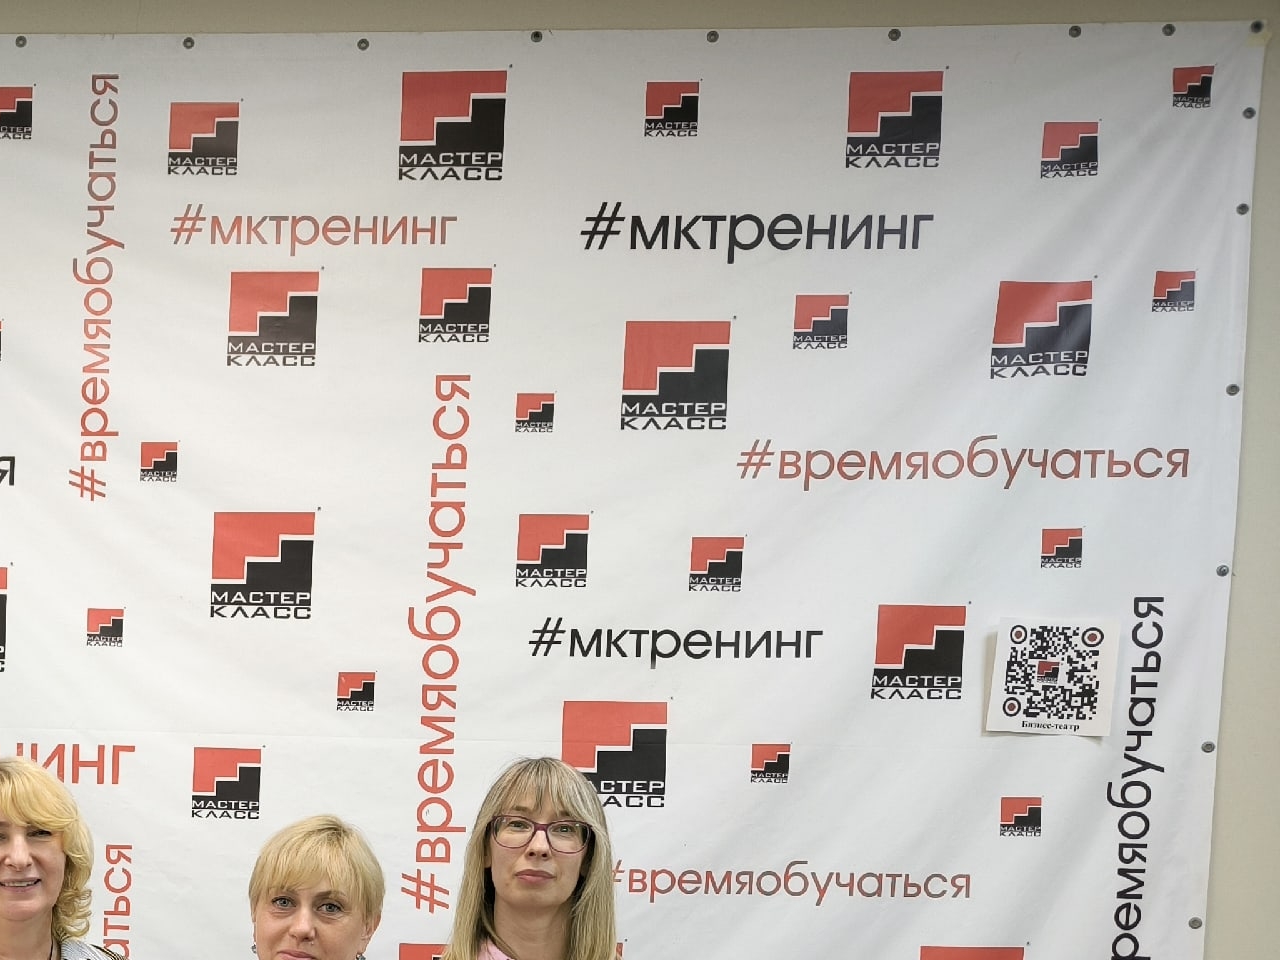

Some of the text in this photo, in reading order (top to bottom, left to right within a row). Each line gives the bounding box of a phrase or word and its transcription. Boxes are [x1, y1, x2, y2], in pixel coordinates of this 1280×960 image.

[644, 122, 696, 130] МАСТЕР
[846, 142, 939, 156] МАСТЕР
[168, 157, 237, 166] МАСТЕР
[399, 153, 502, 166] МАСТЕР
[846, 157, 939, 168] КЛАСС
[1041, 160, 1097, 171] МАСТЕР
[168, 166, 237, 175] КЛАСС
[399, 167, 502, 180] КЛАСС
[1041, 170, 1097, 178] КЛАСС
[171, 203, 457, 256] #мктренинг
[580, 202, 934, 264] #мктренинг
[68, 73, 124, 502] #времяобучаться
[419, 324, 489, 333] МАСТЕР
[419, 333, 489, 342] КЛАСС
[227, 342, 315, 354] МАСТЕР
[227, 355, 315, 366] КЛАСС
[991, 351, 1087, 366] МАСТЕР
[990, 366, 1087, 379] КЛАСС
[621, 403, 726, 416] МАСТЕР
[621, 417, 726, 430] КЛАСС
[737, 435, 1190, 491] #времяобучаться
[516, 569, 586, 578] МАСТЕР
[516, 578, 586, 587] КЛАСС
[689, 577, 741, 585] МАСТЕР
[210, 592, 311, 606] МАСТЕР
[210, 606, 311, 619] КЛАСС
[400, 374, 477, 913] #времяобучаться
[528, 617, 824, 670] #мктренинг
[871, 676, 961, 687] МАСТЕР
[871, 688, 961, 699] КЛАСС
[600, 780, 665, 793] СТЕР
[192, 801, 259, 810] МАСТЕР
[602, 795, 665, 808] АСС
[192, 810, 259, 819] КЛАСС
